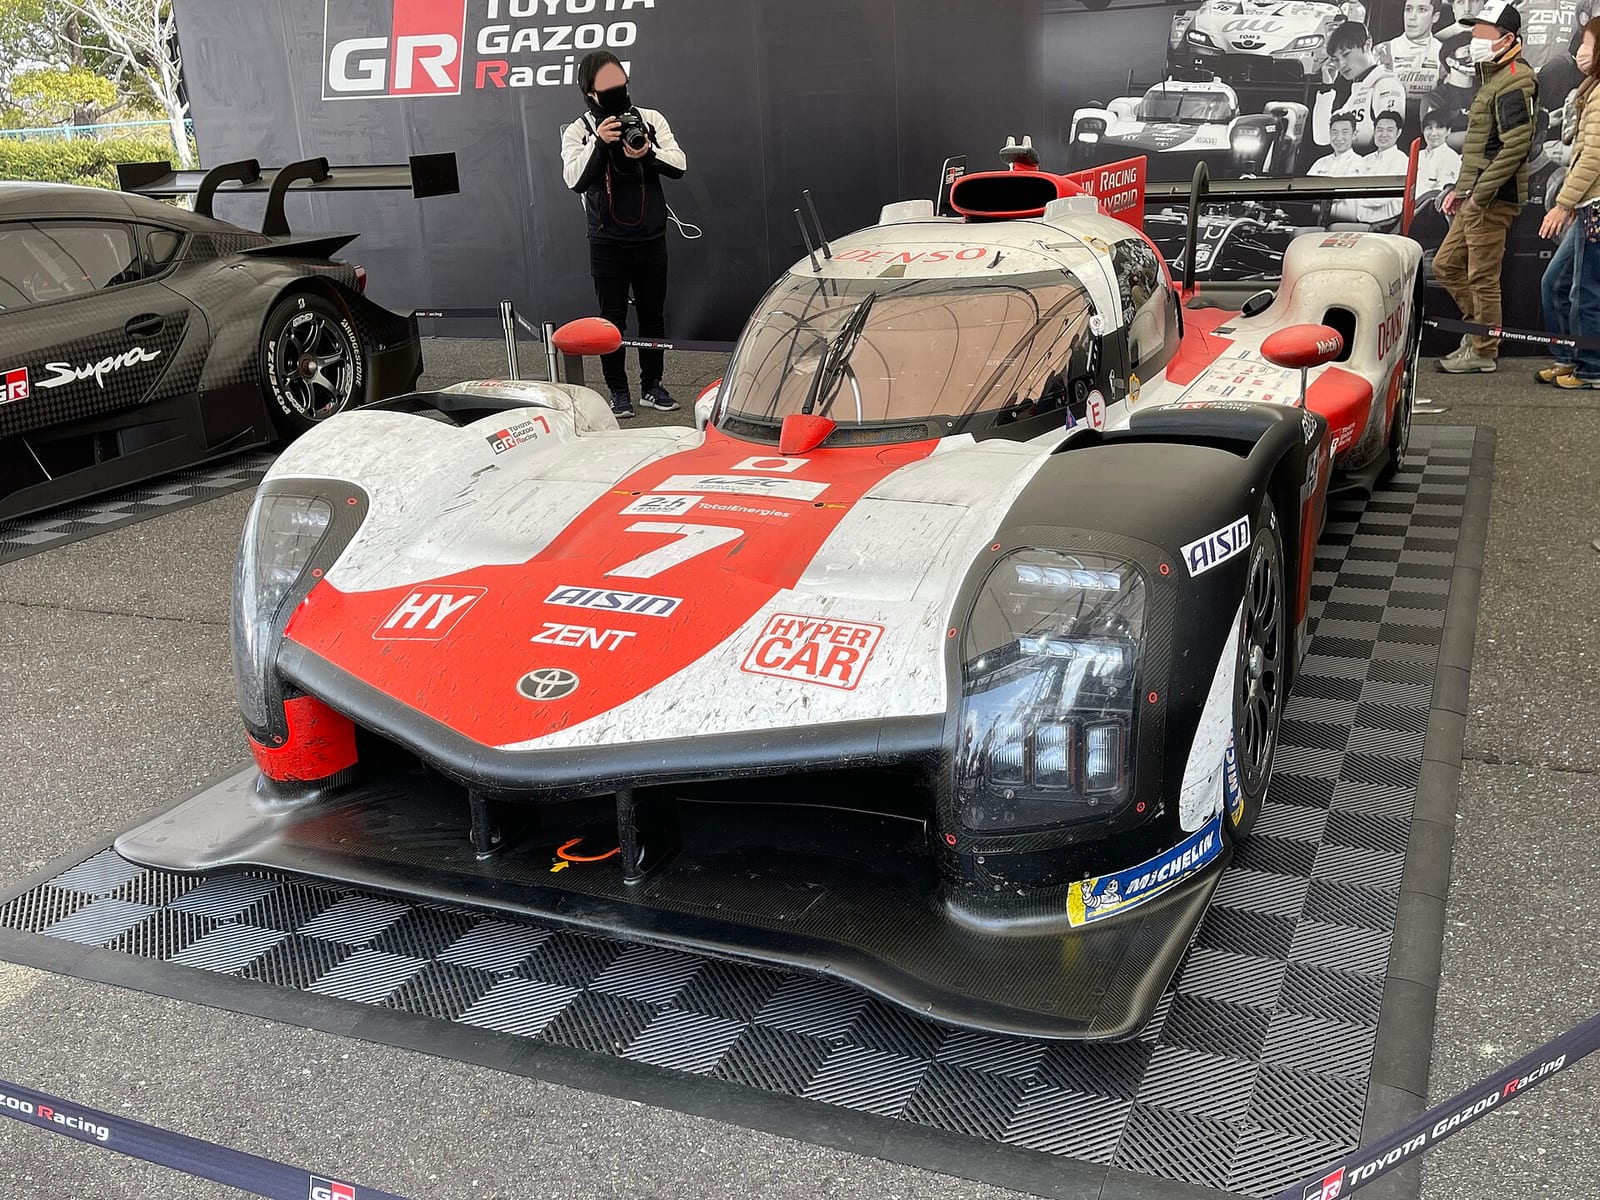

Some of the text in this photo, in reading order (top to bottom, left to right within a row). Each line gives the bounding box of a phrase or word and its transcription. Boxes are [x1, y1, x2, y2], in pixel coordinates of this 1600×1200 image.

[1528, 9, 1576, 25] ZENT
[476, 21, 637, 53] GAZOO
[328, 33, 456, 92] GR
[1100, 167, 1137, 193] RACING
[832, 247, 988, 264] DENSO
[341, 318, 363, 388] BRIDGESTONE
[1501, 331, 1526, 341] TOYOTA
[1526, 335, 1551, 343] GAZOO
[1551, 337, 1576, 347] Racing
[35, 347, 161, 389] Supra
[267, 341, 292, 415] POTENZA
[508, 420, 532, 432] TOYOTA
[532, 415, 551, 434] 7
[1091, 402, 1102, 427] E
[491, 435, 517, 454] GR
[512, 426, 534, 438] GAZOO
[516, 432, 538, 445] Racing
[698, 503, 791, 519] TotalEnergies
[603, 522, 745, 579] 7
[383, 592, 477, 630] HY
[529, 622, 637, 651] ZENT
[769, 618, 872, 649] HYPER
[755, 636, 861, 682] CAR
[1125, 831, 1215, 895] MICHELIN
[37, 1104, 109, 1142] Racing
[1349, 1053, 1567, 1187] TOYOTA GAZOO Racing
